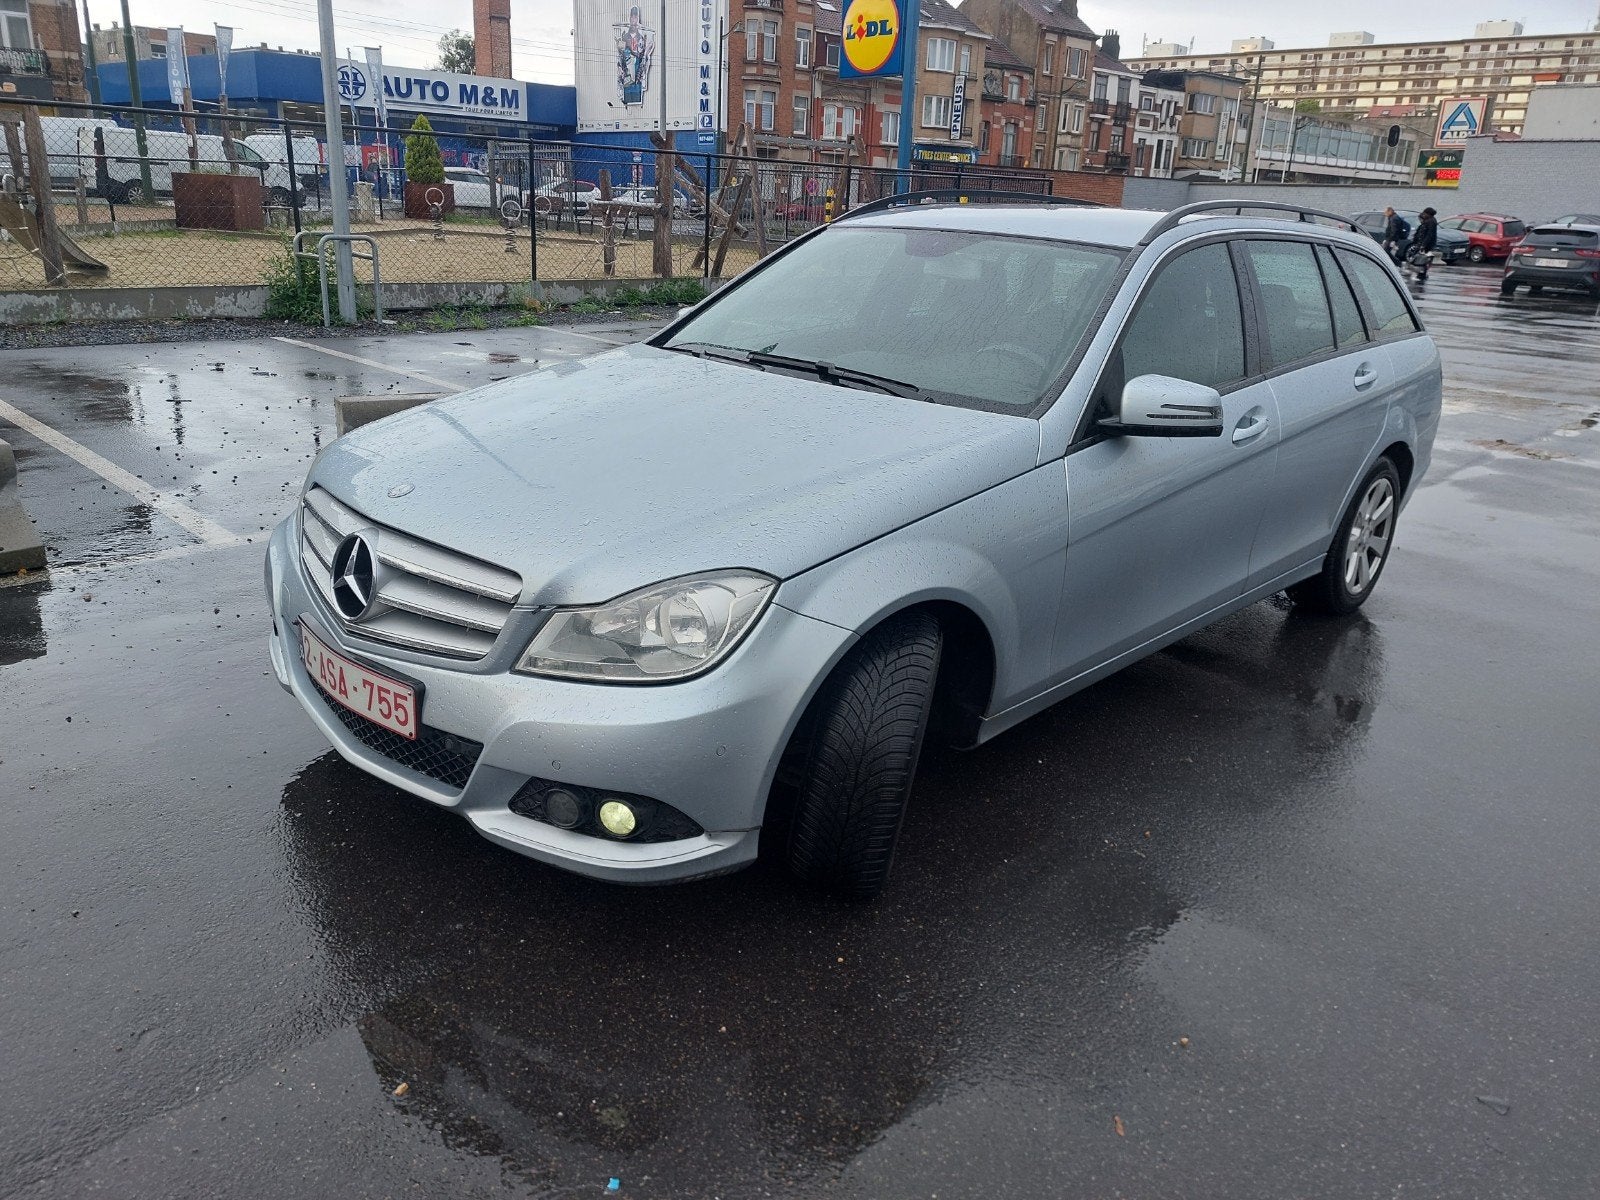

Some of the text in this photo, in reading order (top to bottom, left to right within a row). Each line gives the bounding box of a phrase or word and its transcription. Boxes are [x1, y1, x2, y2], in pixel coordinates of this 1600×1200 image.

[459, 83, 519, 109] M&M
[700, 64, 710, 112] M&M
[952, 85, 963, 132] PNEUS
[304, 635, 409, 727] 2-ASA-755
